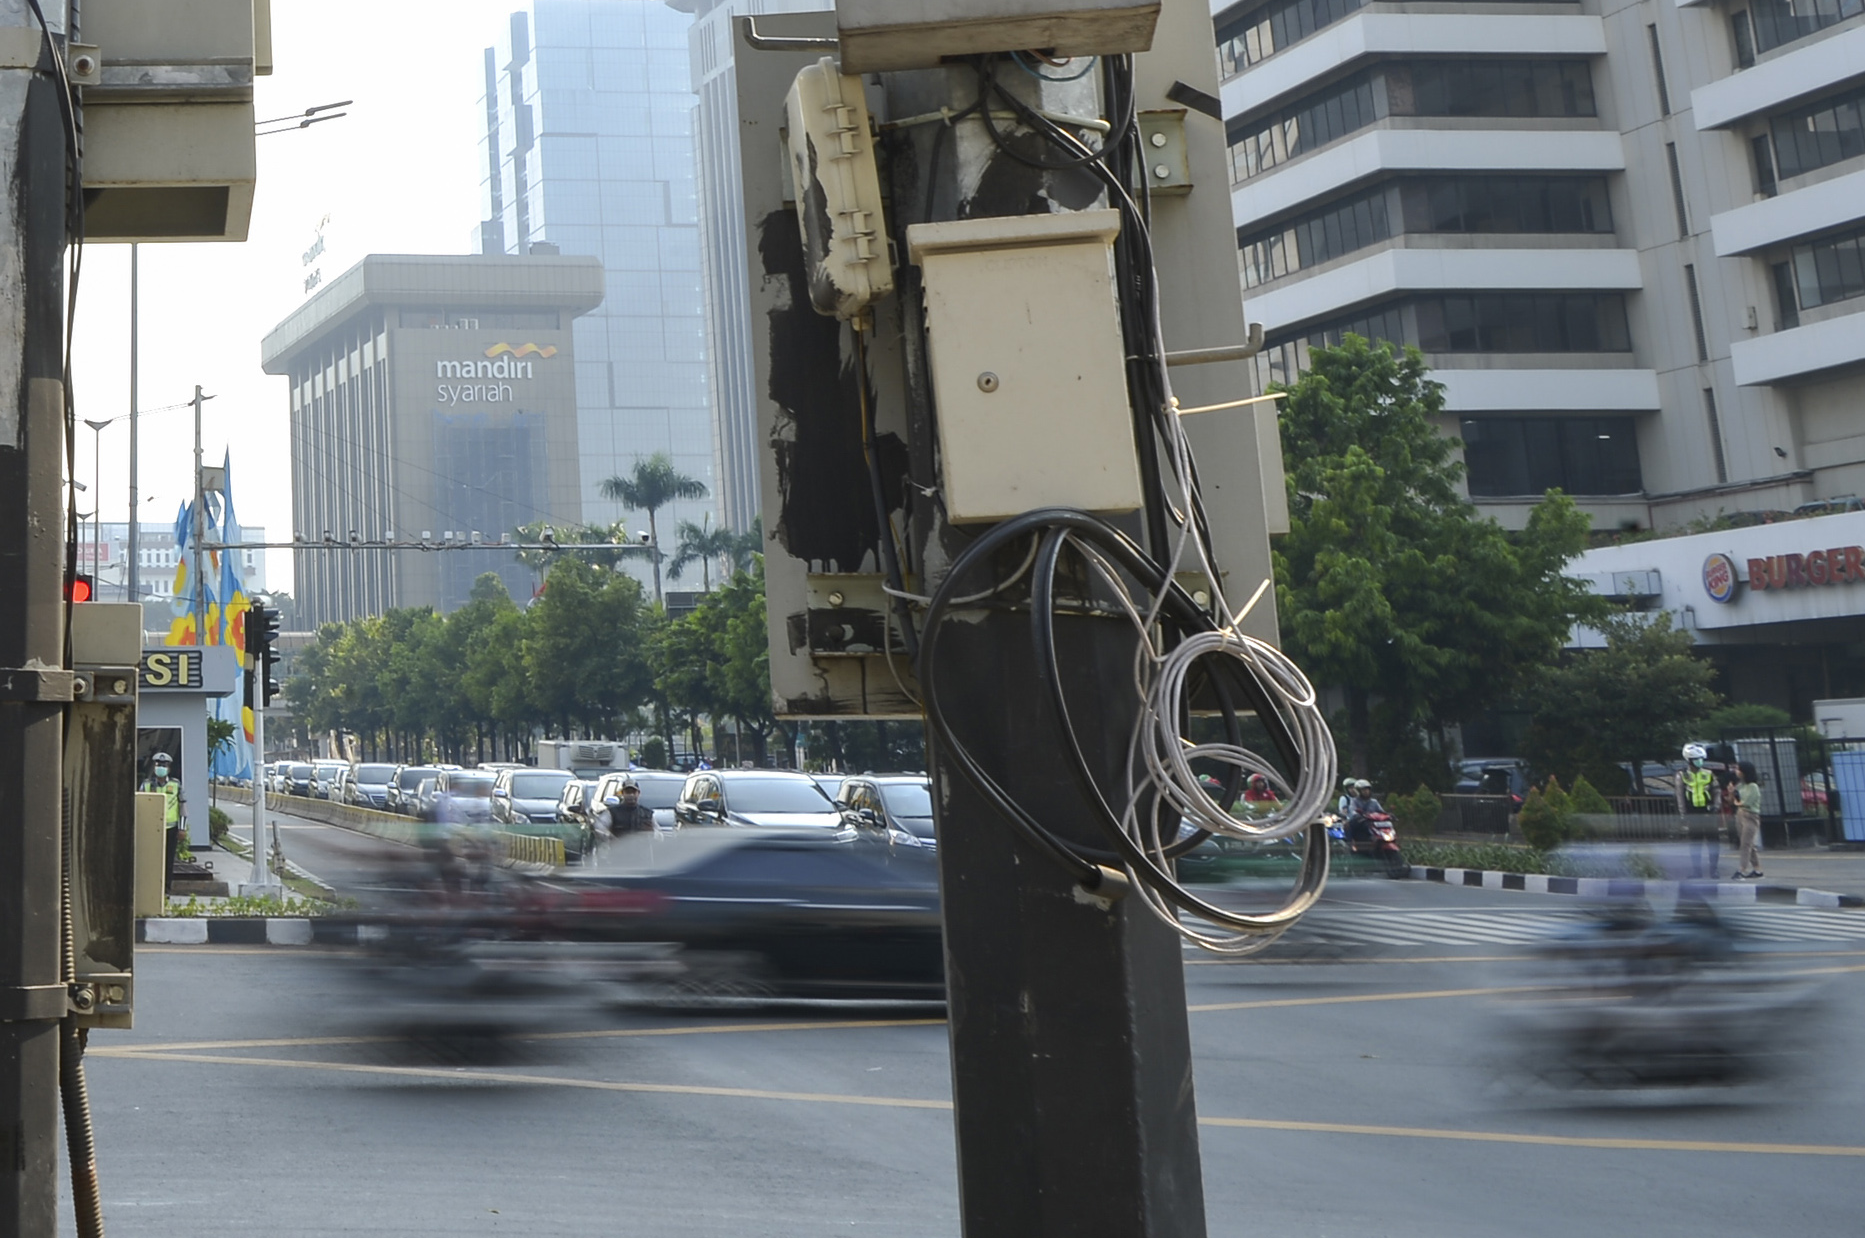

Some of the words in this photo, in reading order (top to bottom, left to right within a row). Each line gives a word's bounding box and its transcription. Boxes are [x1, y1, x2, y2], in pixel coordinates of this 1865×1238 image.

[437, 355, 531, 378] mandiri
[438, 382, 512, 407] syariah
[1709, 571, 1728, 590] KING
[1748, 546, 1865, 591] BURGER
